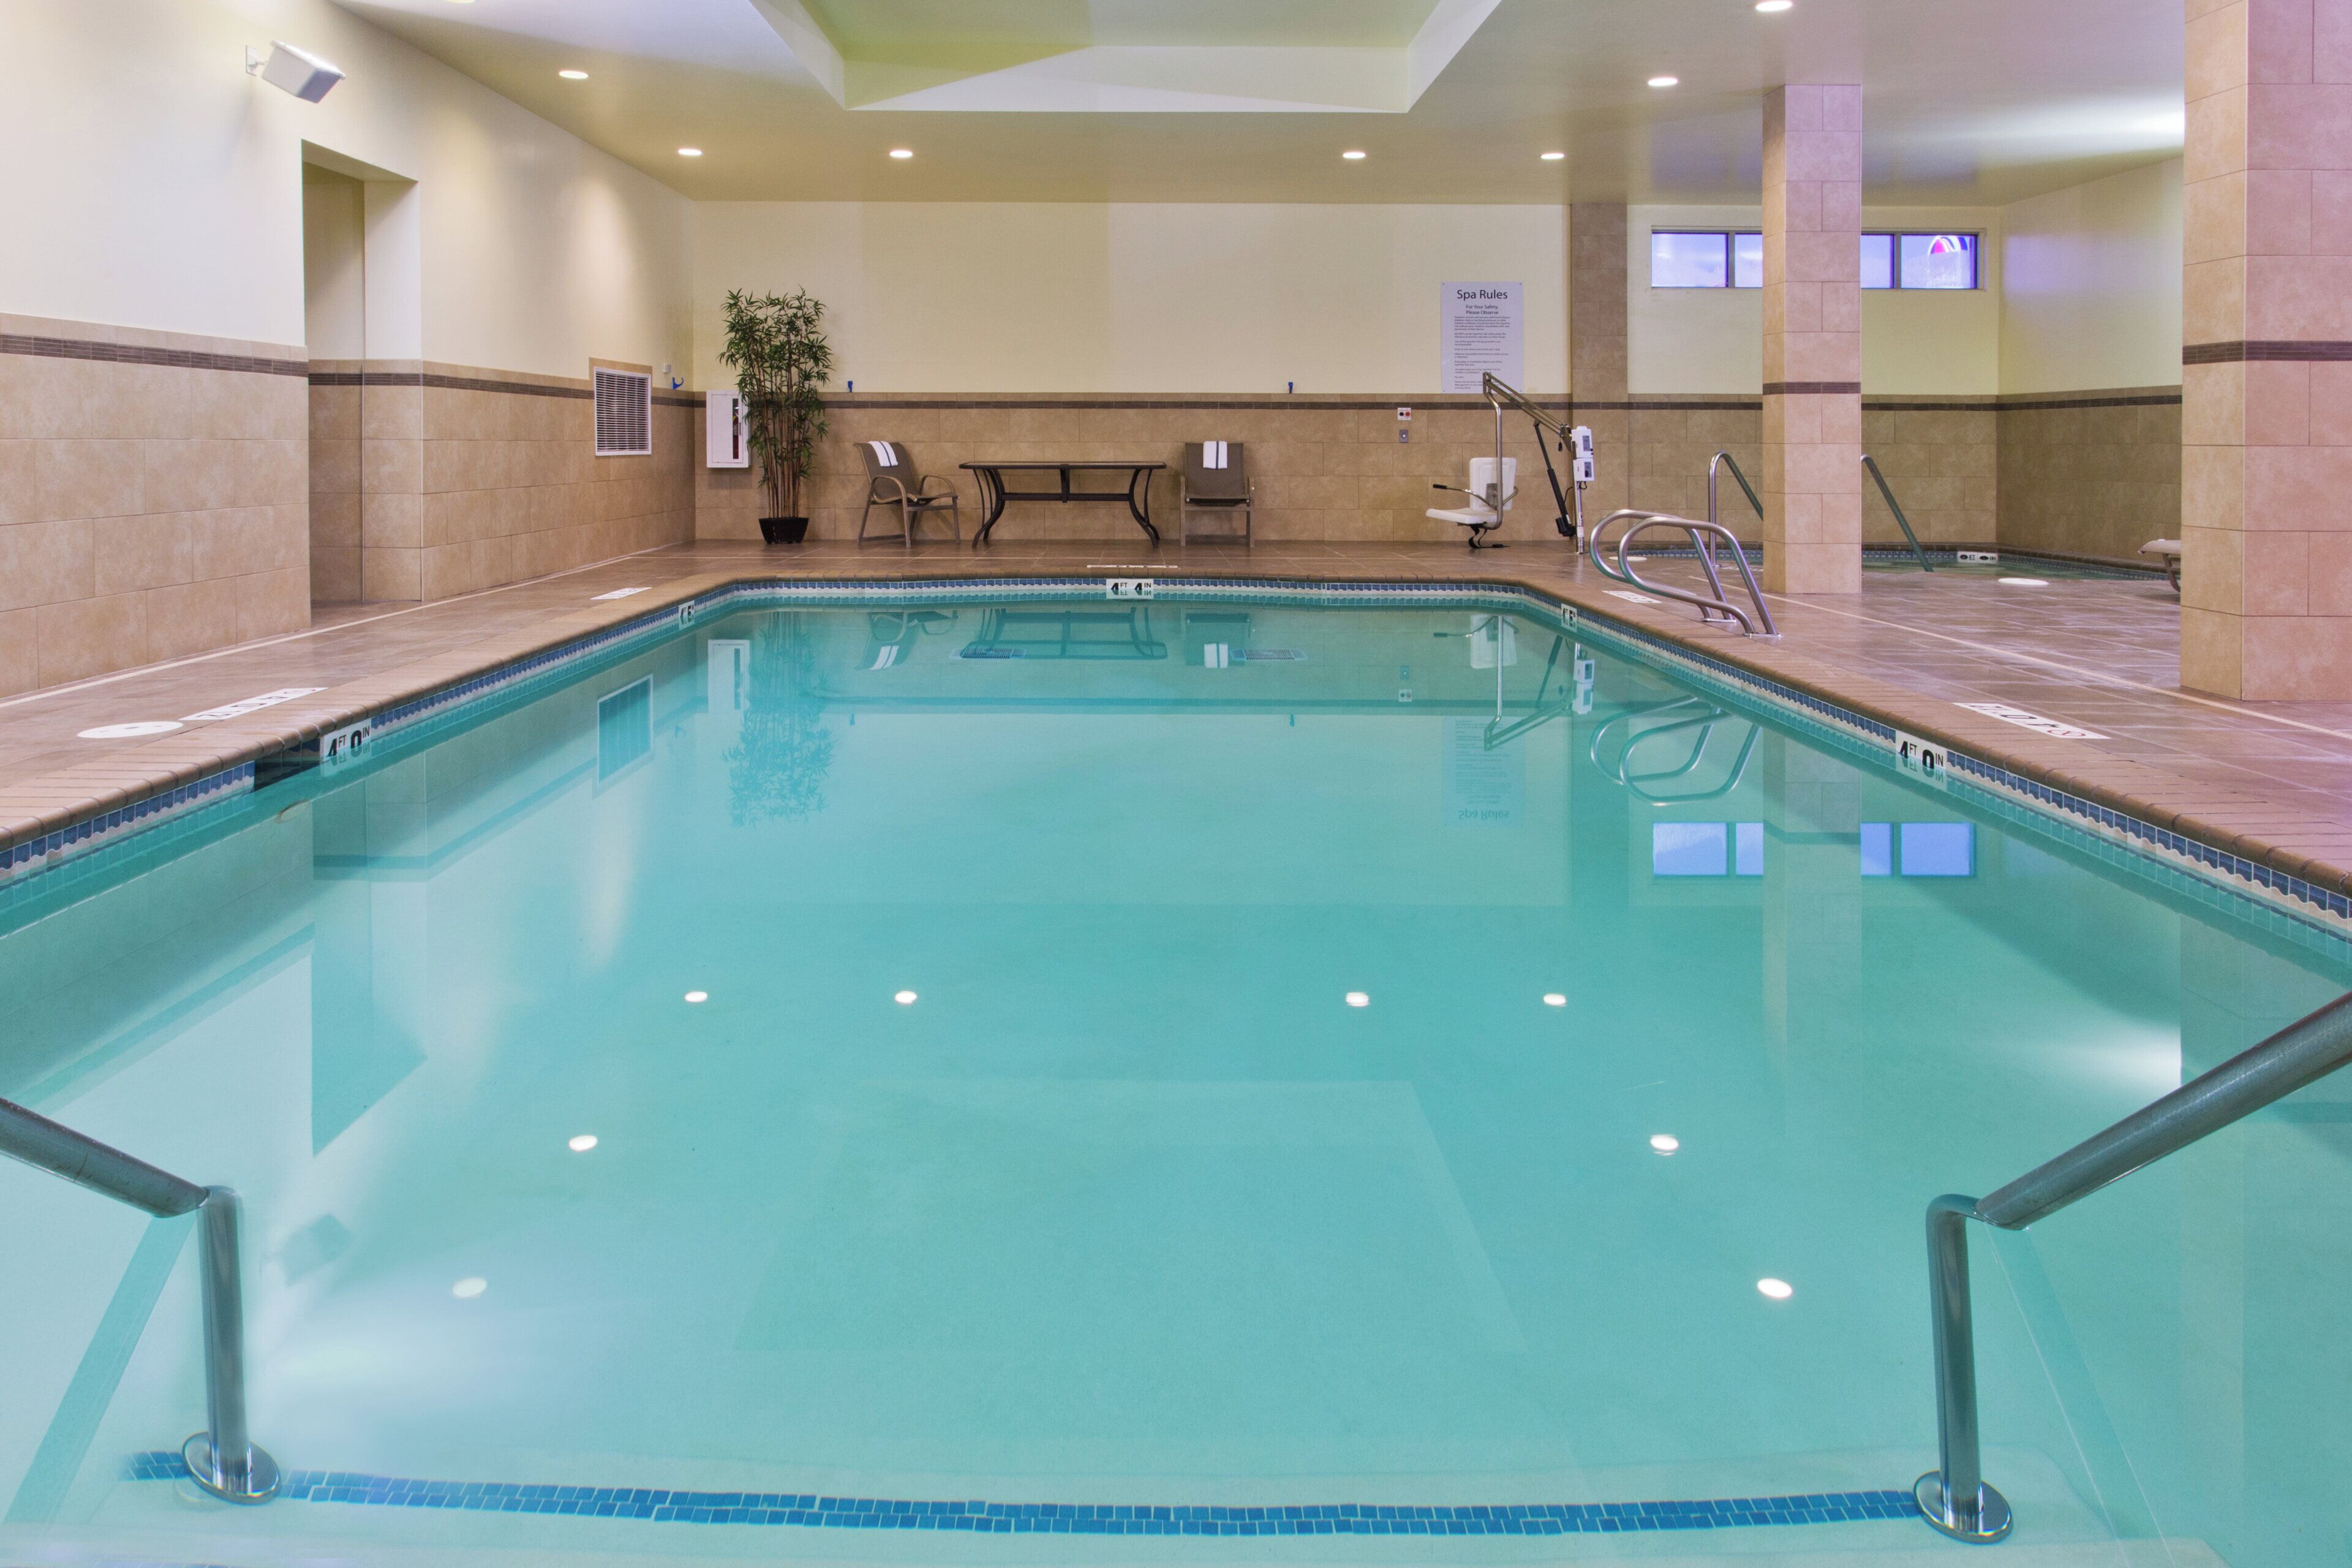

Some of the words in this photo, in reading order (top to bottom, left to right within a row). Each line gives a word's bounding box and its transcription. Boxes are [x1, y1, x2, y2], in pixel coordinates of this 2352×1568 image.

[1457, 289, 1476, 301] Spa
[1480, 289, 1508, 300] Rules
[328, 738, 337, 757] 4
[338, 734, 347, 748] FT
[350, 729, 362, 749] 0
[363, 725, 371, 739] IN
[1899, 741, 1909, 759] 4
[1909, 743, 1917, 756] FT
[1922, 749, 1934, 769] 0
[1935, 753, 1943, 767] IN
